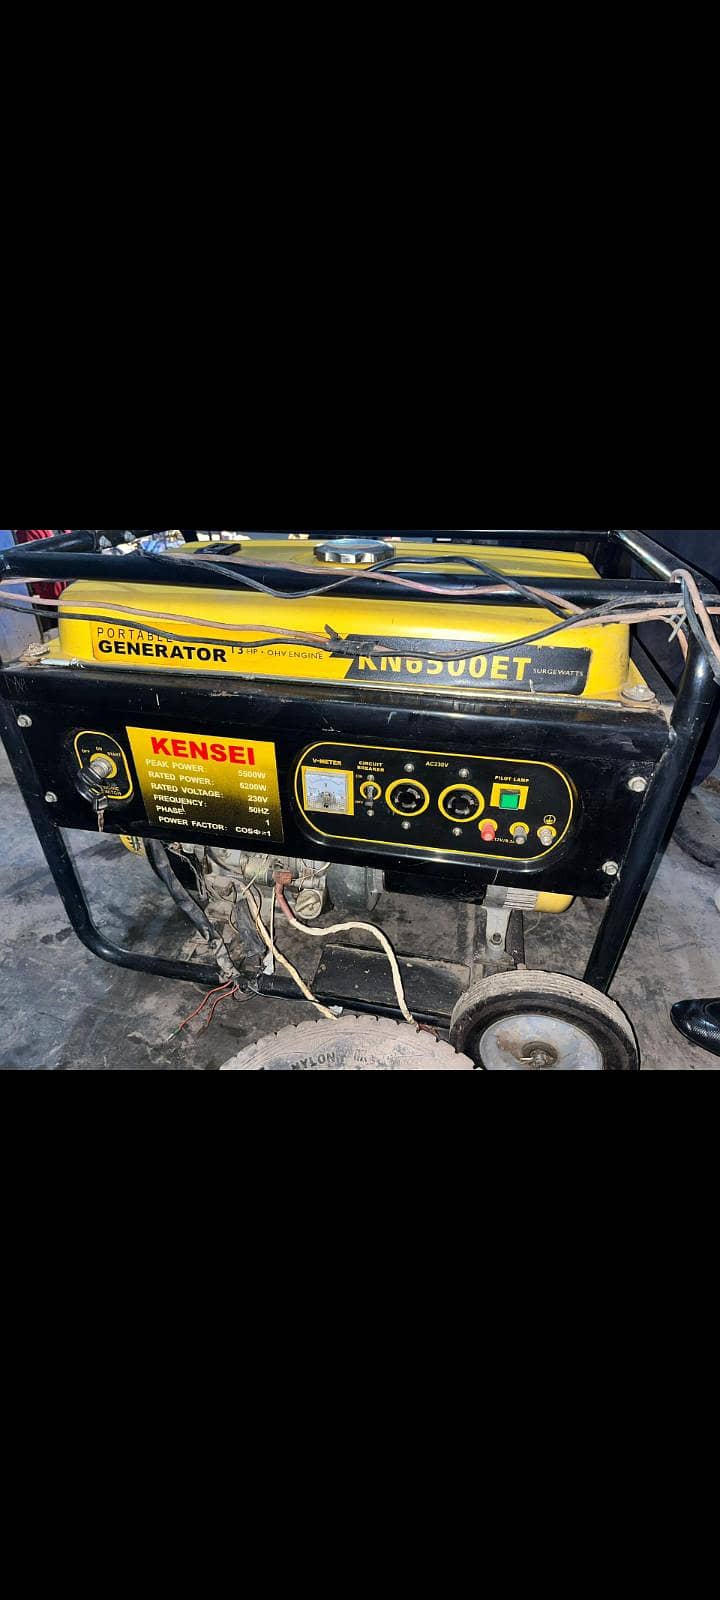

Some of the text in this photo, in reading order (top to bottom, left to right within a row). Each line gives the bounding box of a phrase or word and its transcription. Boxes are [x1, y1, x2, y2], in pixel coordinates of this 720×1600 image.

[97, 627, 172, 643] PORTABL
[98, 640, 227, 663] GENERATOR
[266, 649, 287, 657] OHV
[288, 651, 323, 660] ENGINE
[358, 655, 532, 681] KN6500ET
[150, 736, 256, 766] KENSEI
[145, 758, 266, 779] PEAK POWER: 5500W
[312, 757, 342, 766] V-METER
[357, 765, 385, 773] BREAKER
[358, 760, 384, 768] CIRCUIT
[425, 760, 449, 768] AC230V
[148, 771, 176, 781] RATED
[179, 773, 215, 786] POWER:
[150, 782, 269, 803] RATED VOLTAGE: 230V
[153, 794, 270, 815] FREQUENCY: 50HZ
[158, 815, 189, 826] POWER
[191, 820, 228, 831] FACTOR:
[291, 1051, 336, 1070] NYLON
